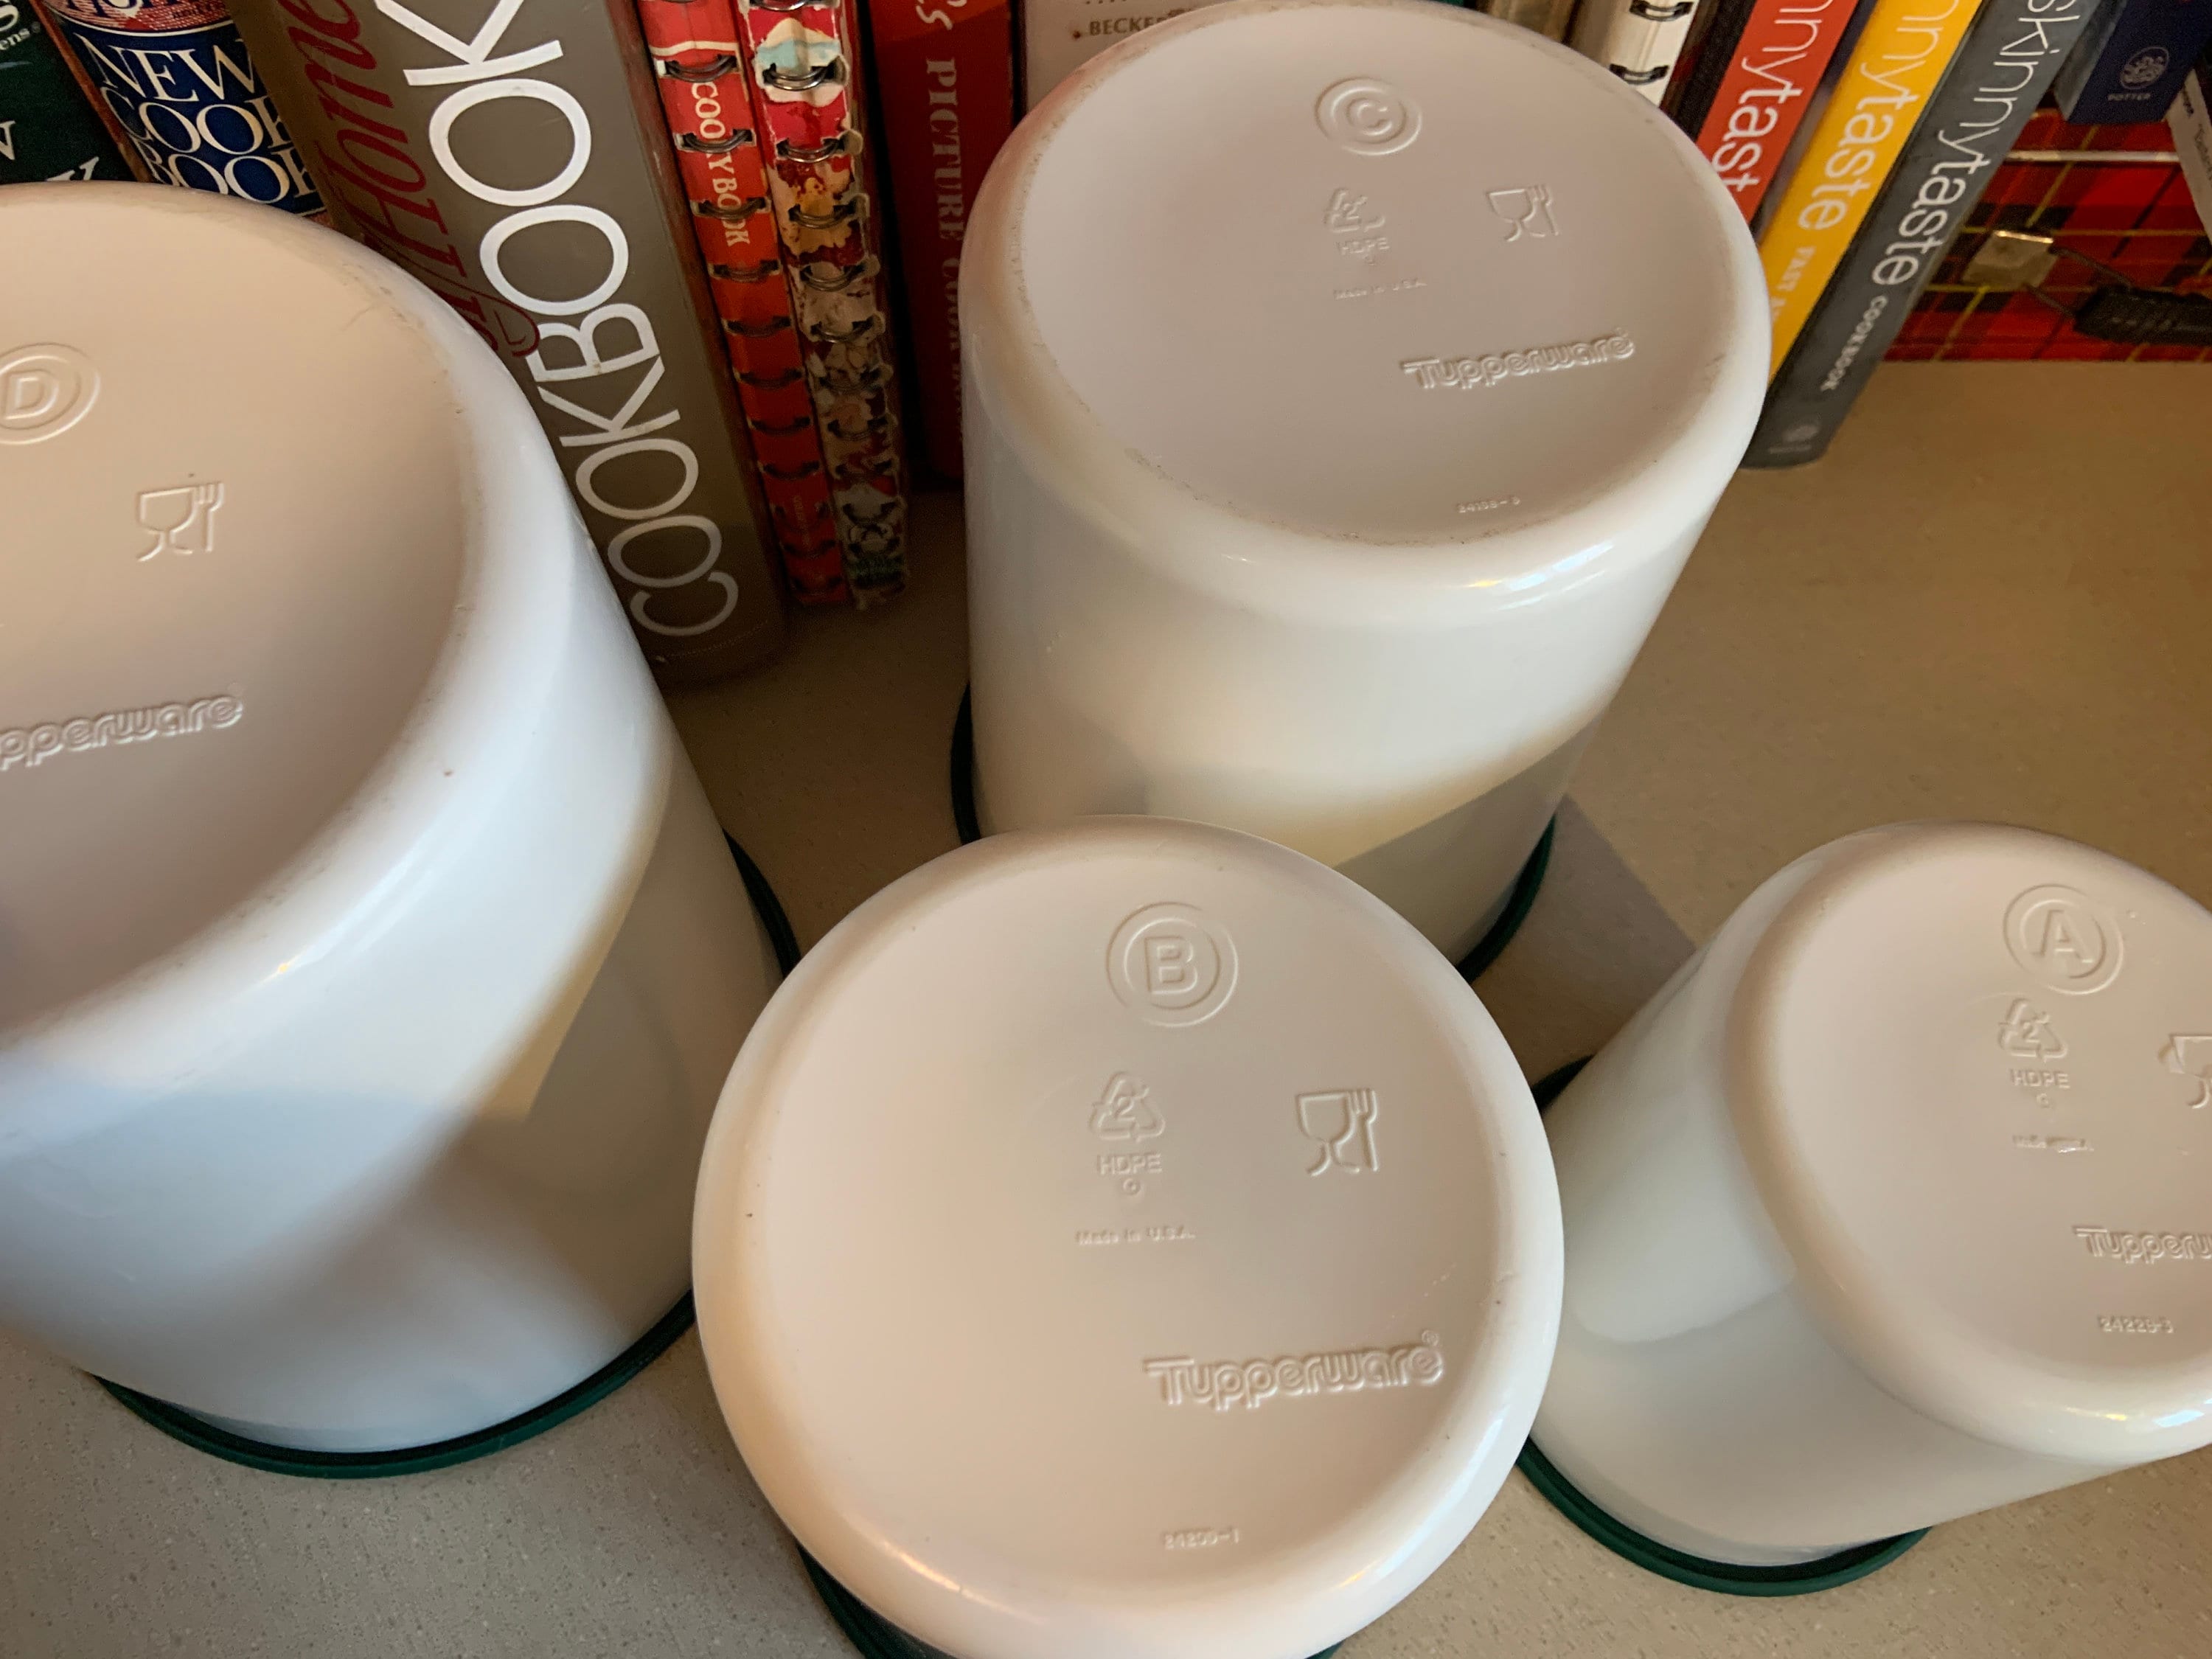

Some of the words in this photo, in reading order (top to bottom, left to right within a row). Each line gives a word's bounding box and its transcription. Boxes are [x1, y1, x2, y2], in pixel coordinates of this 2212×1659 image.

[1089, 16, 1166, 36] BECKE
[74, 32, 255, 102] NEW
[692, 81, 735, 175] COOY
[926, 58, 965, 241] PICTURE
[1335, 237, 1390, 256] HDPE
[375, 0, 738, 636] COOKBOOK
[1401, 332, 1635, 390] Tupperware
[3, 369, 60, 421] D
[1144, 935, 1198, 995] B
[2031, 909, 2093, 964] A
[2008, 1068, 2071, 1089] HDPE
[1097, 1152, 1163, 1175] HDPE
[1142, 1343, 1446, 1411] Tupperware
